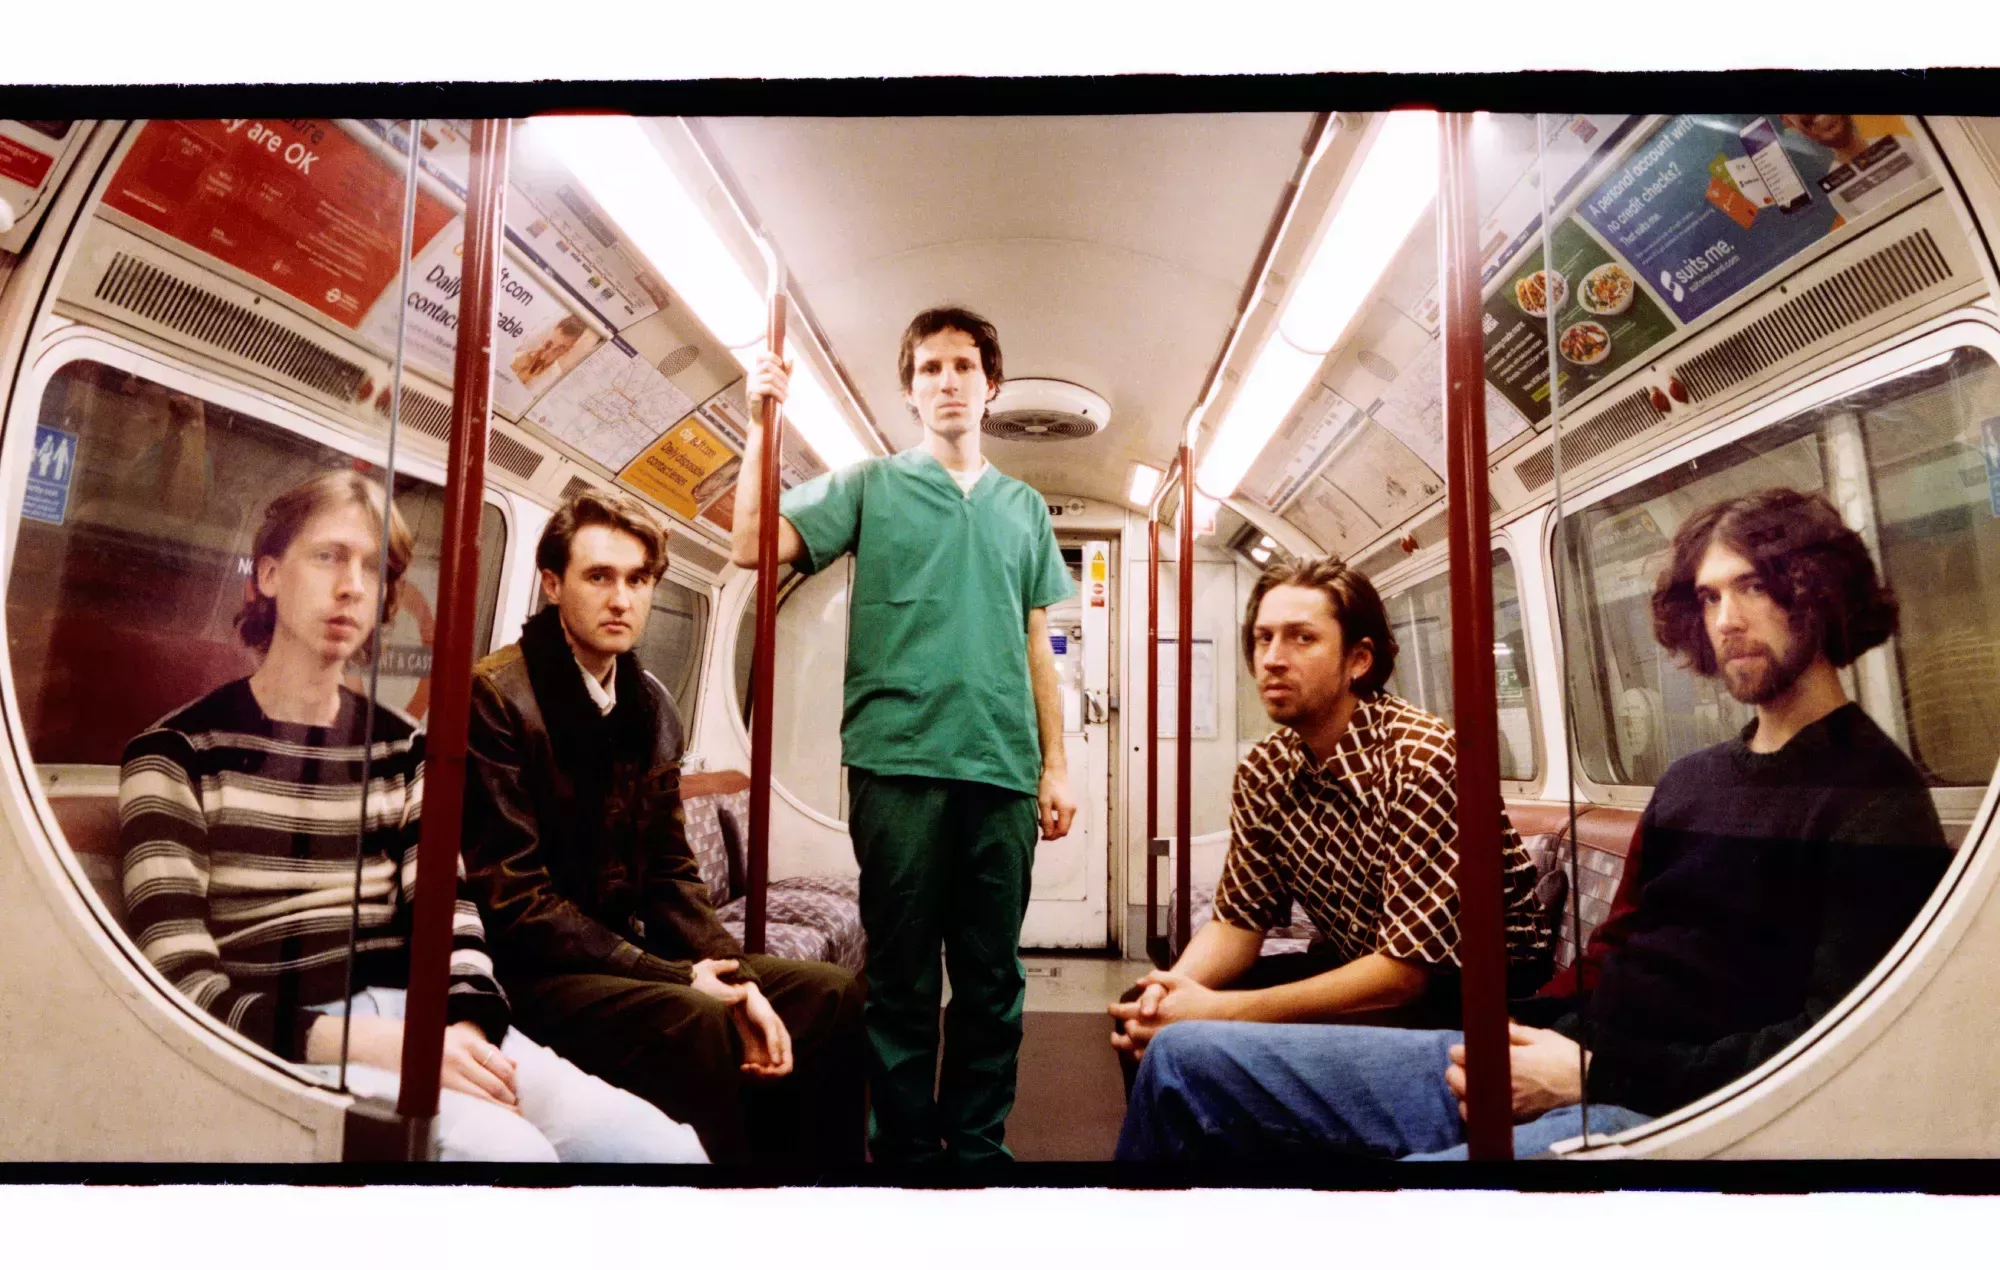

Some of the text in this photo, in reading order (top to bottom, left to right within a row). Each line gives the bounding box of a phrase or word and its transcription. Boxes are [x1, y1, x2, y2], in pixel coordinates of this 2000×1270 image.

[247, 123, 282, 152] are
[284, 143, 319, 175] OK
[1588, 115, 1696, 217] A personal account with
[1607, 161, 1682, 233] no credit checks?
[426, 264, 461, 299] Daily
[1675, 240, 1735, 284] suits me.
